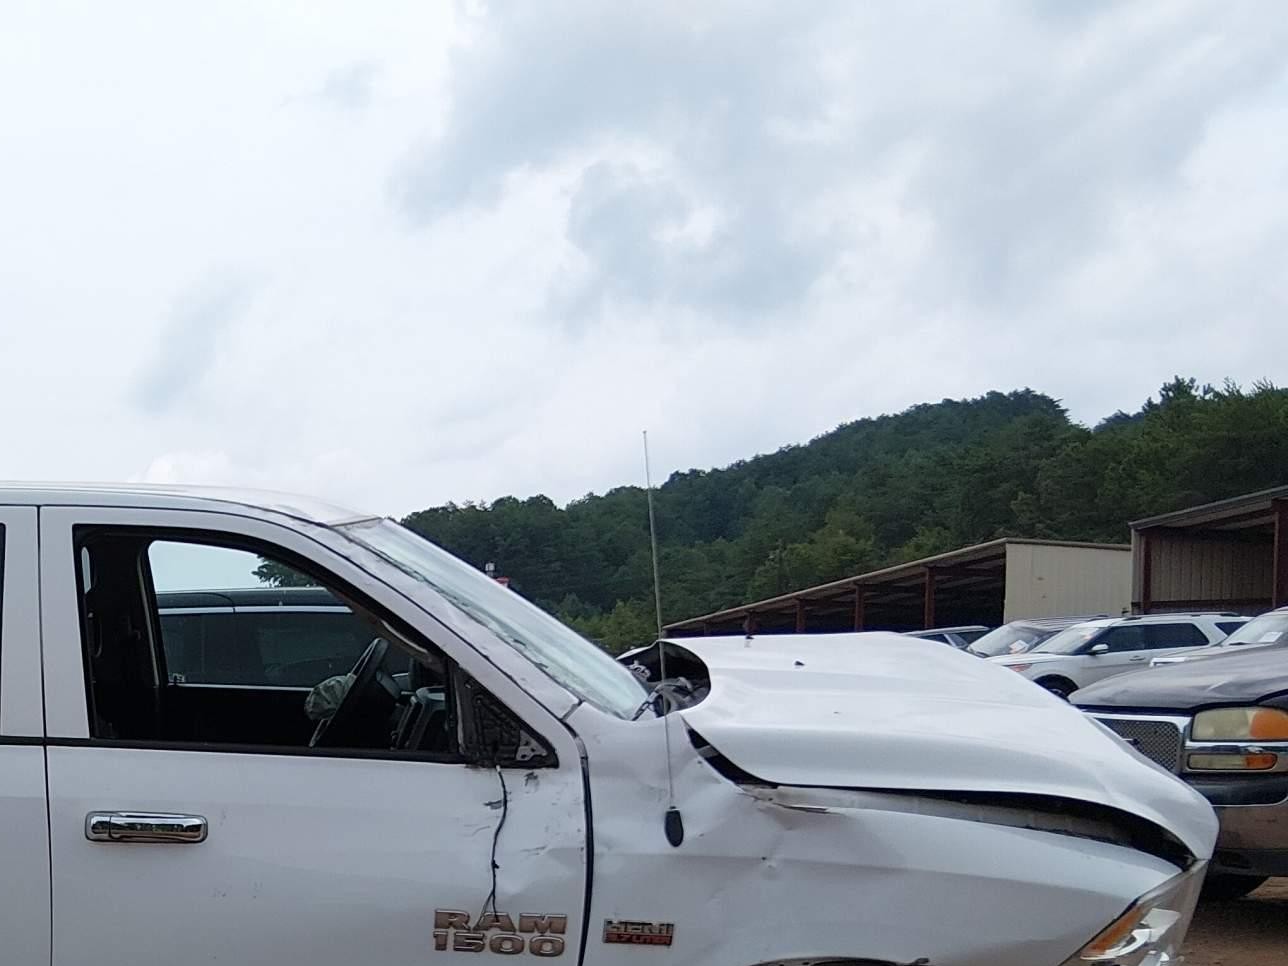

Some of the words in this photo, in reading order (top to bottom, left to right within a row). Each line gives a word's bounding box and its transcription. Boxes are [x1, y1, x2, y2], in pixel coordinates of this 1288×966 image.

[434, 909, 567, 934] RAM
[606, 920, 674, 936] HEMI
[432, 930, 565, 957] 1500
